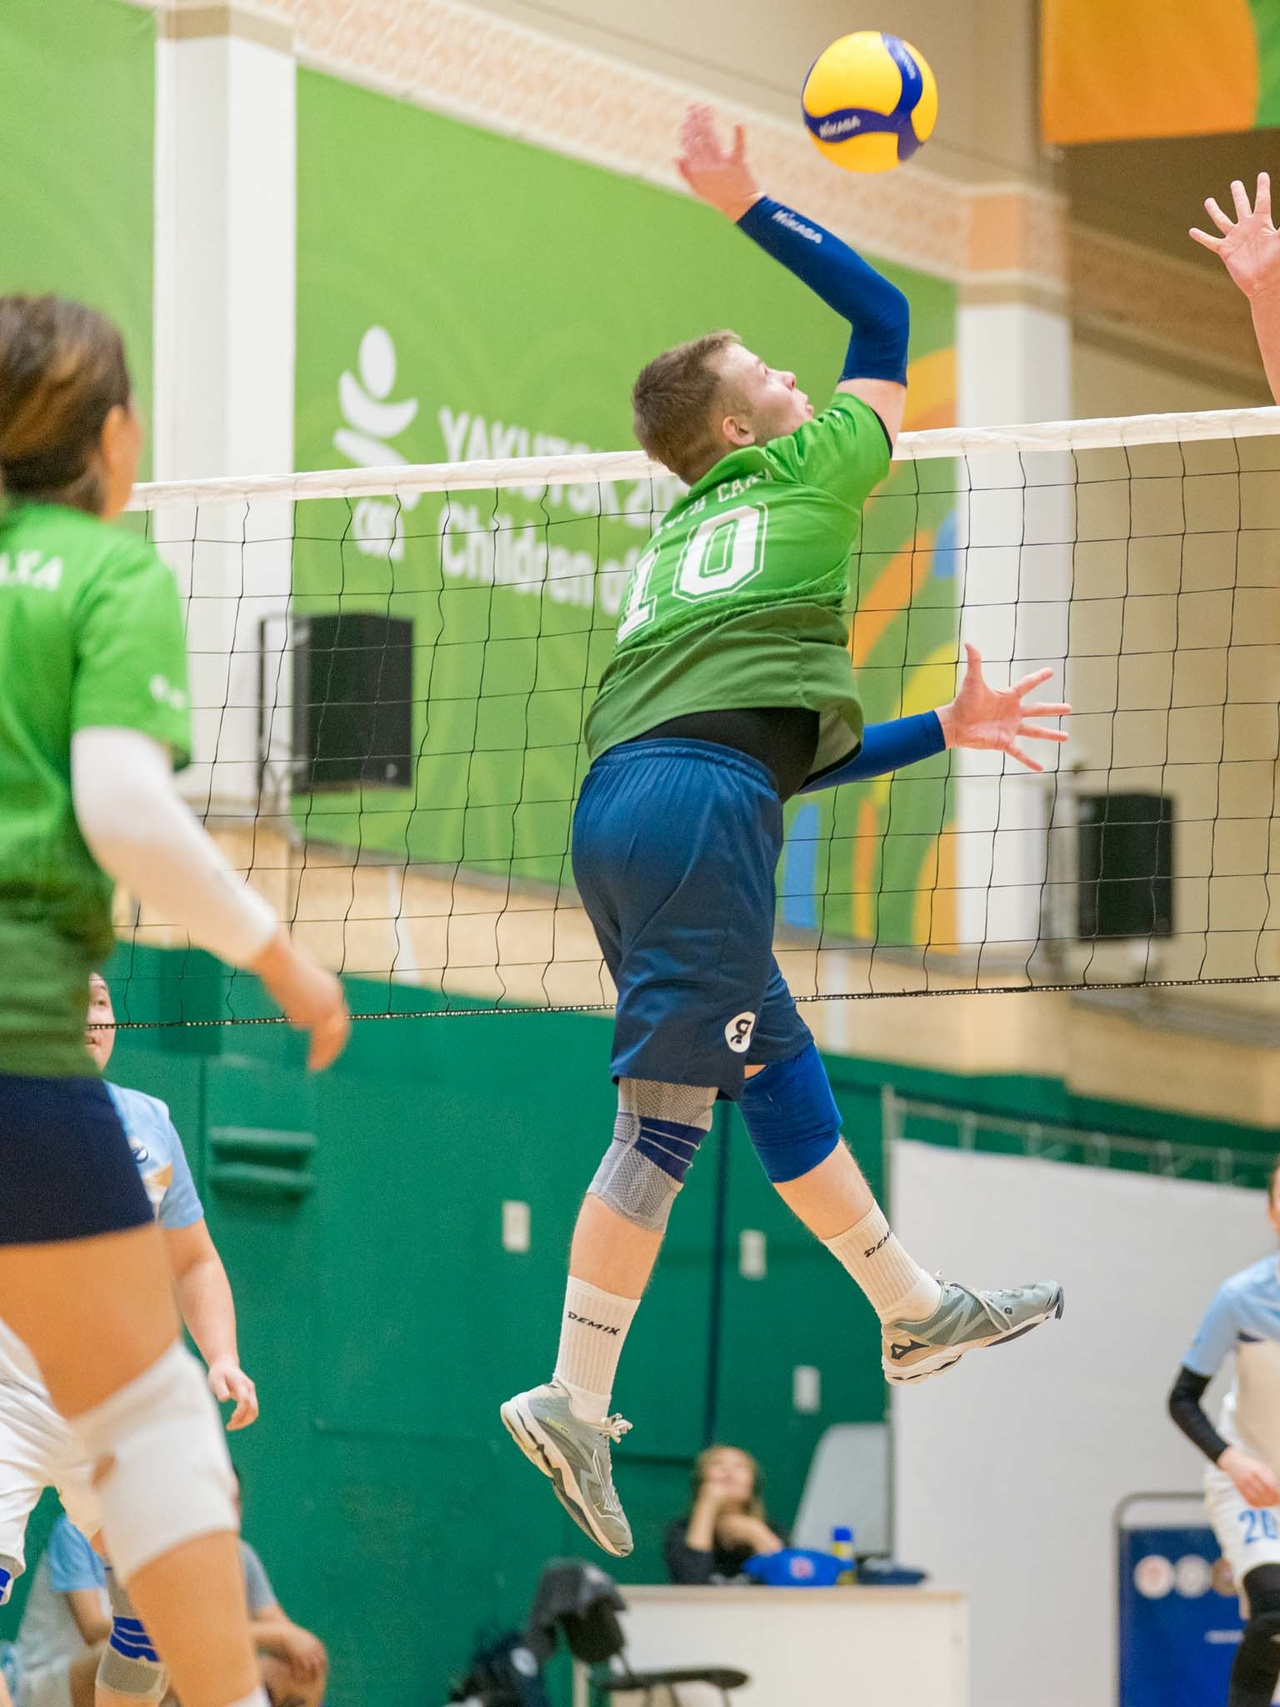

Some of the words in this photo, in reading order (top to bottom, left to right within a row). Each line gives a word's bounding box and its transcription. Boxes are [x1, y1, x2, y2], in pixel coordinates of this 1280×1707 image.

[437, 501, 594, 611] Children
[616, 502, 768, 646] 10
[567, 1310, 621, 1336] DEMIX
[1239, 1508, 1279, 1545] 20
